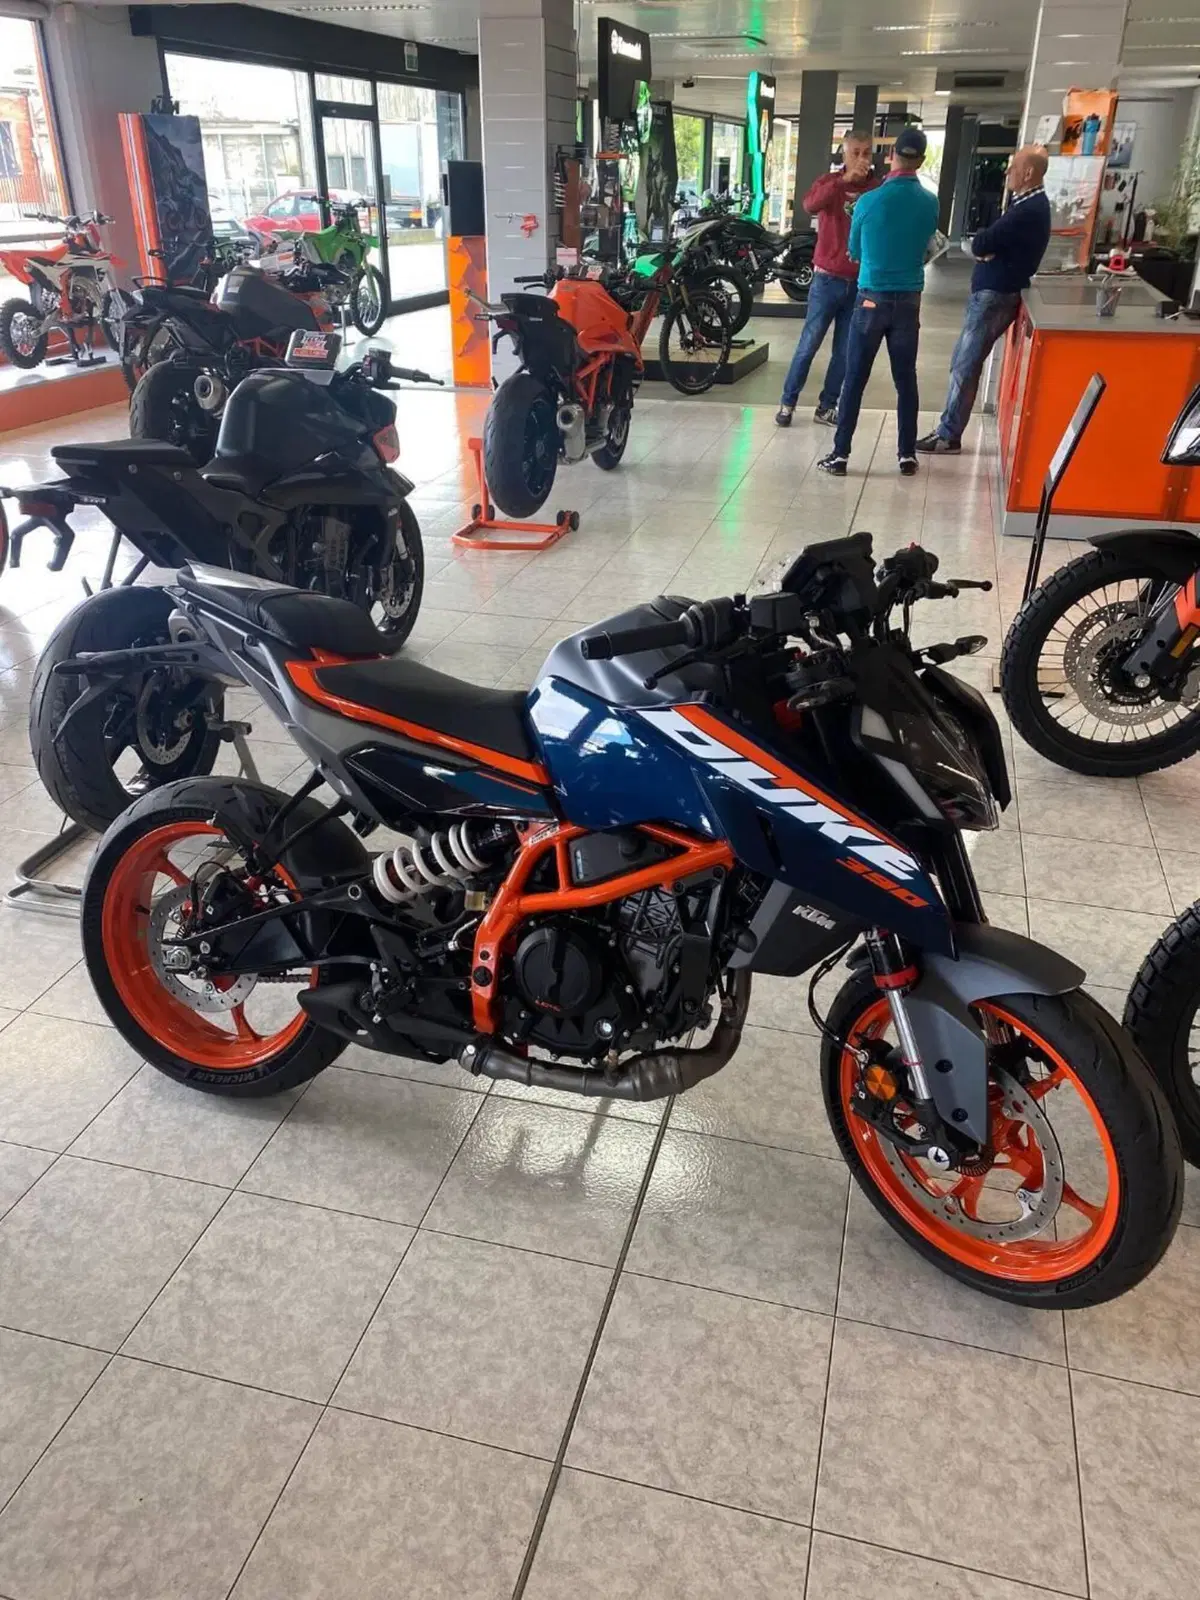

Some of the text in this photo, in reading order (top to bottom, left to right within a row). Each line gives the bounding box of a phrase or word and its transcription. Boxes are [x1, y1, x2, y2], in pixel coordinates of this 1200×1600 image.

[635, 707, 921, 881] DUKE
[836, 856, 930, 908] 390
[792, 904, 837, 930] KTM
[192, 1070, 256, 1084] MICHELIN
